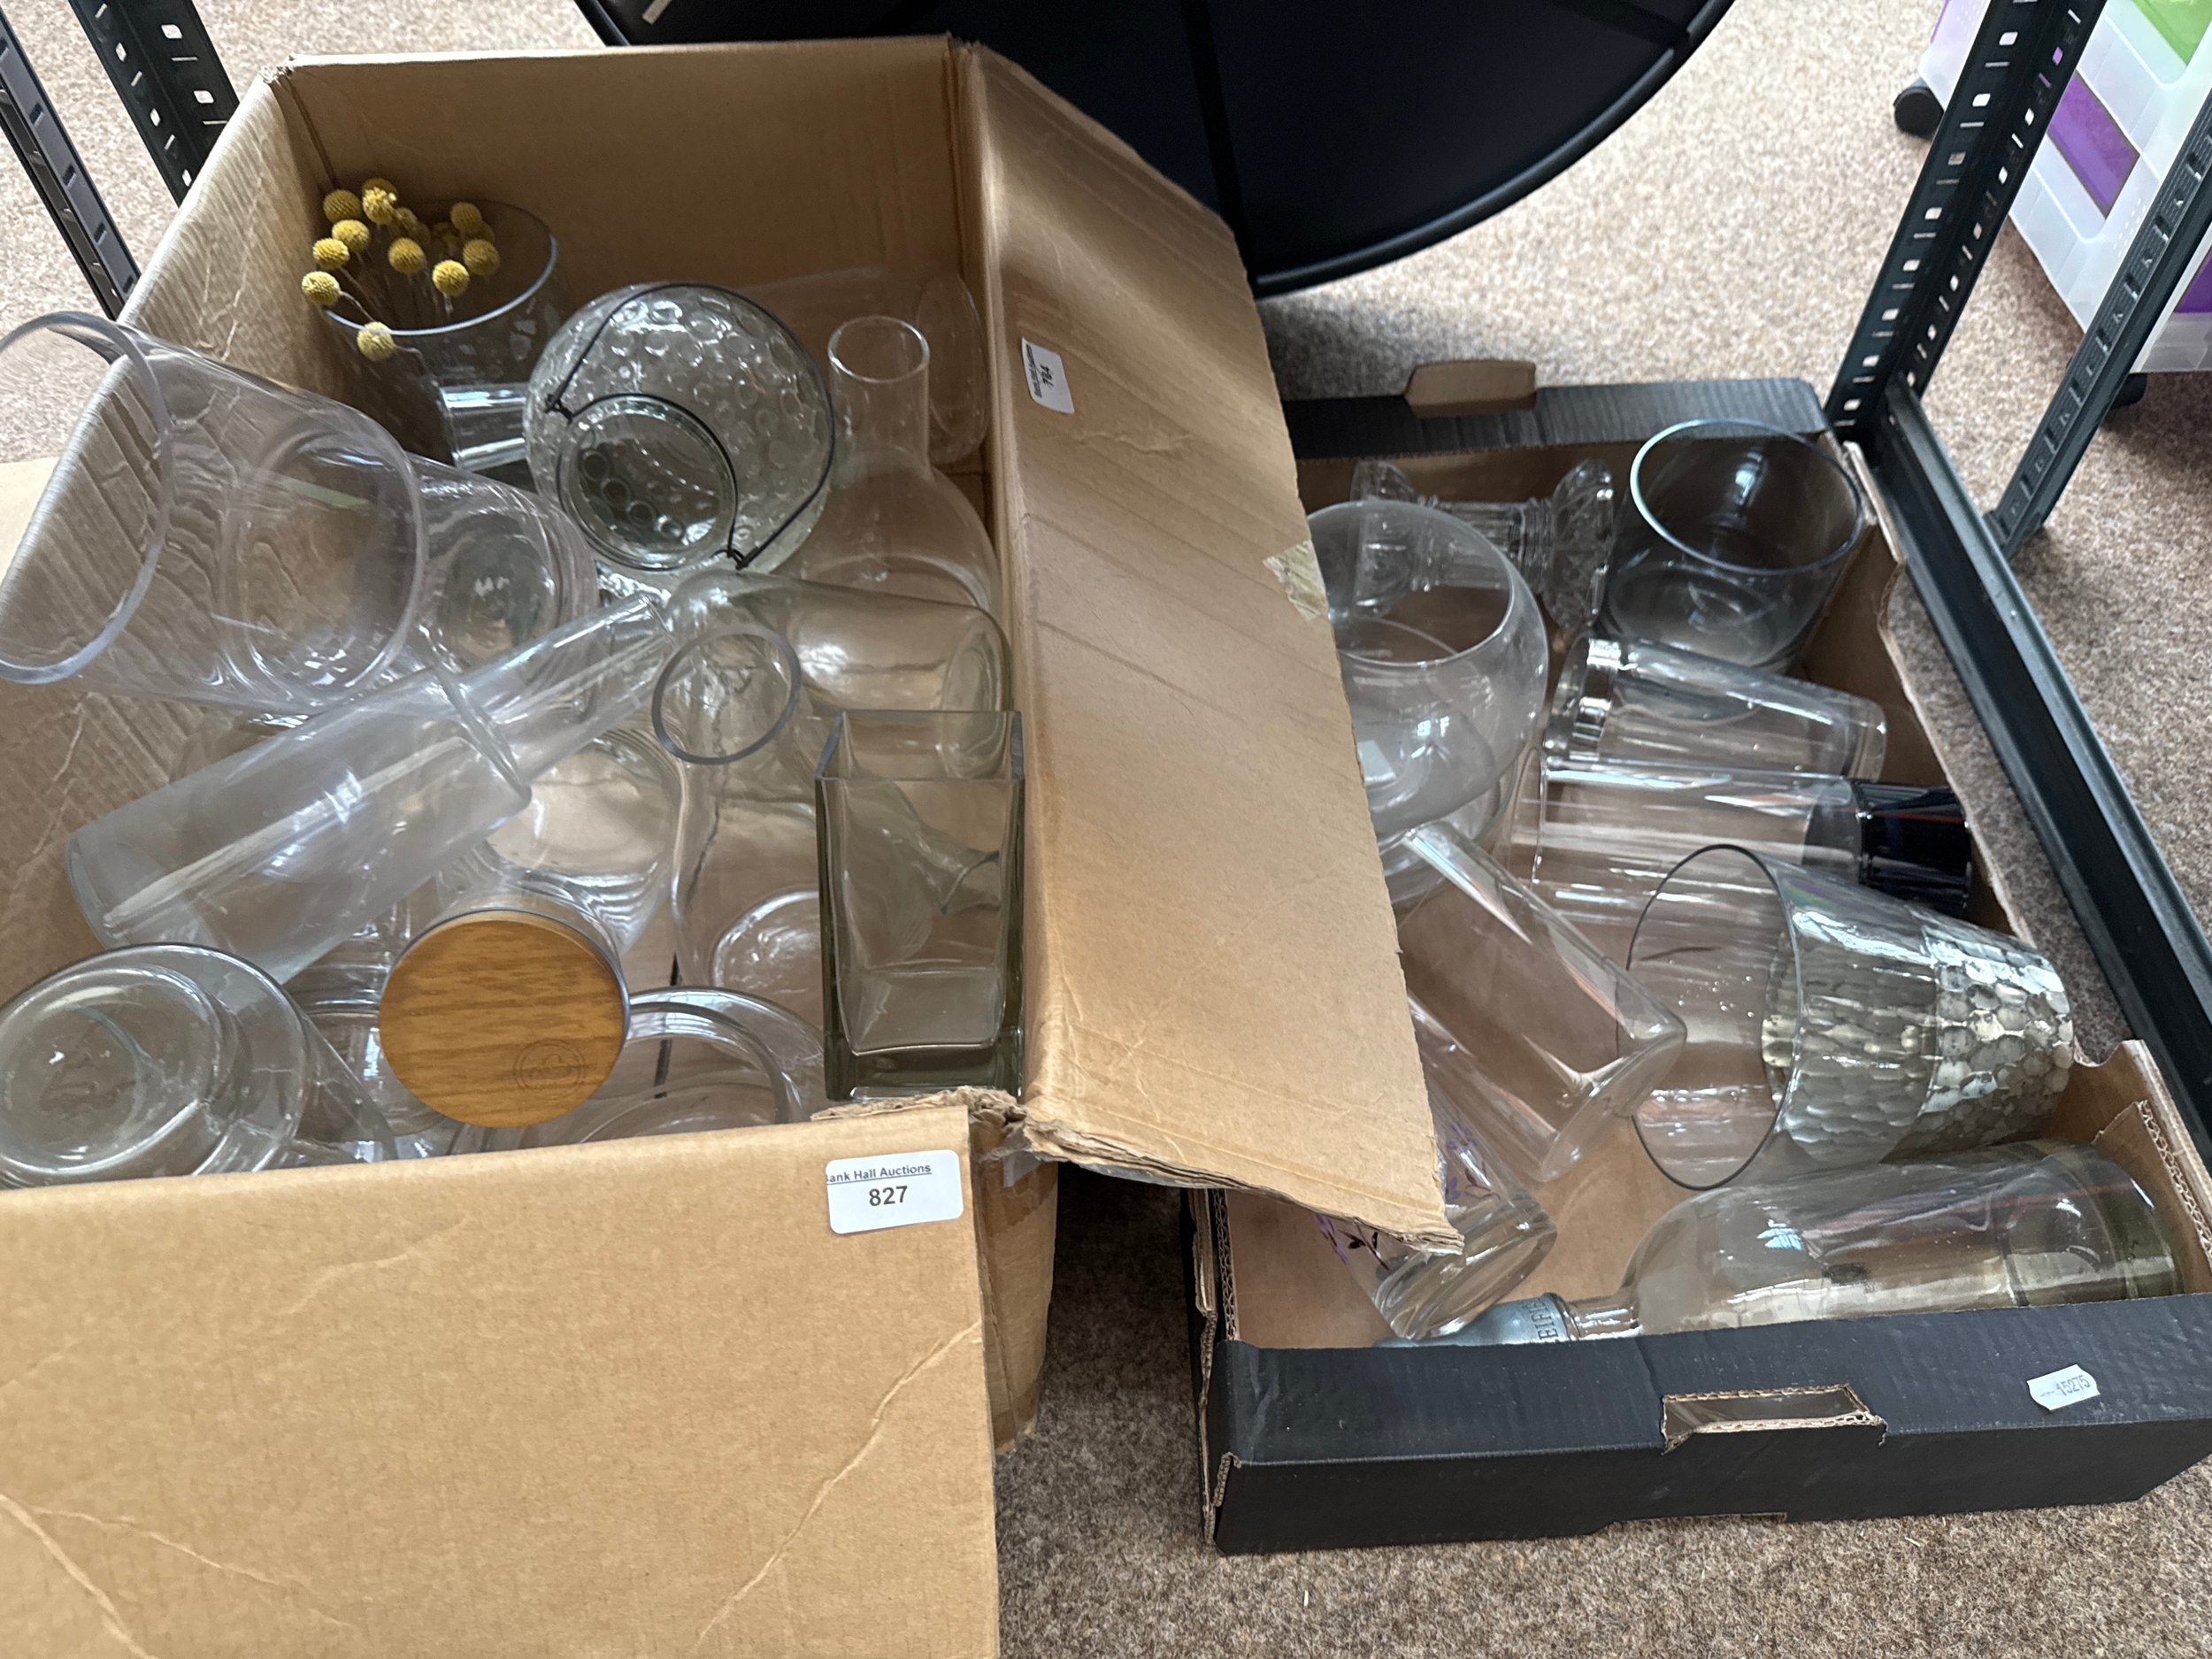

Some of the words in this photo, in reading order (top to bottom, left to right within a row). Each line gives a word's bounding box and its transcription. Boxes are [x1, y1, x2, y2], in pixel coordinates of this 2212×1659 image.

[854, 1169, 876, 1180] Hall
[879, 1164, 932, 1177] Auctions
[868, 1185, 908, 1207] 827
